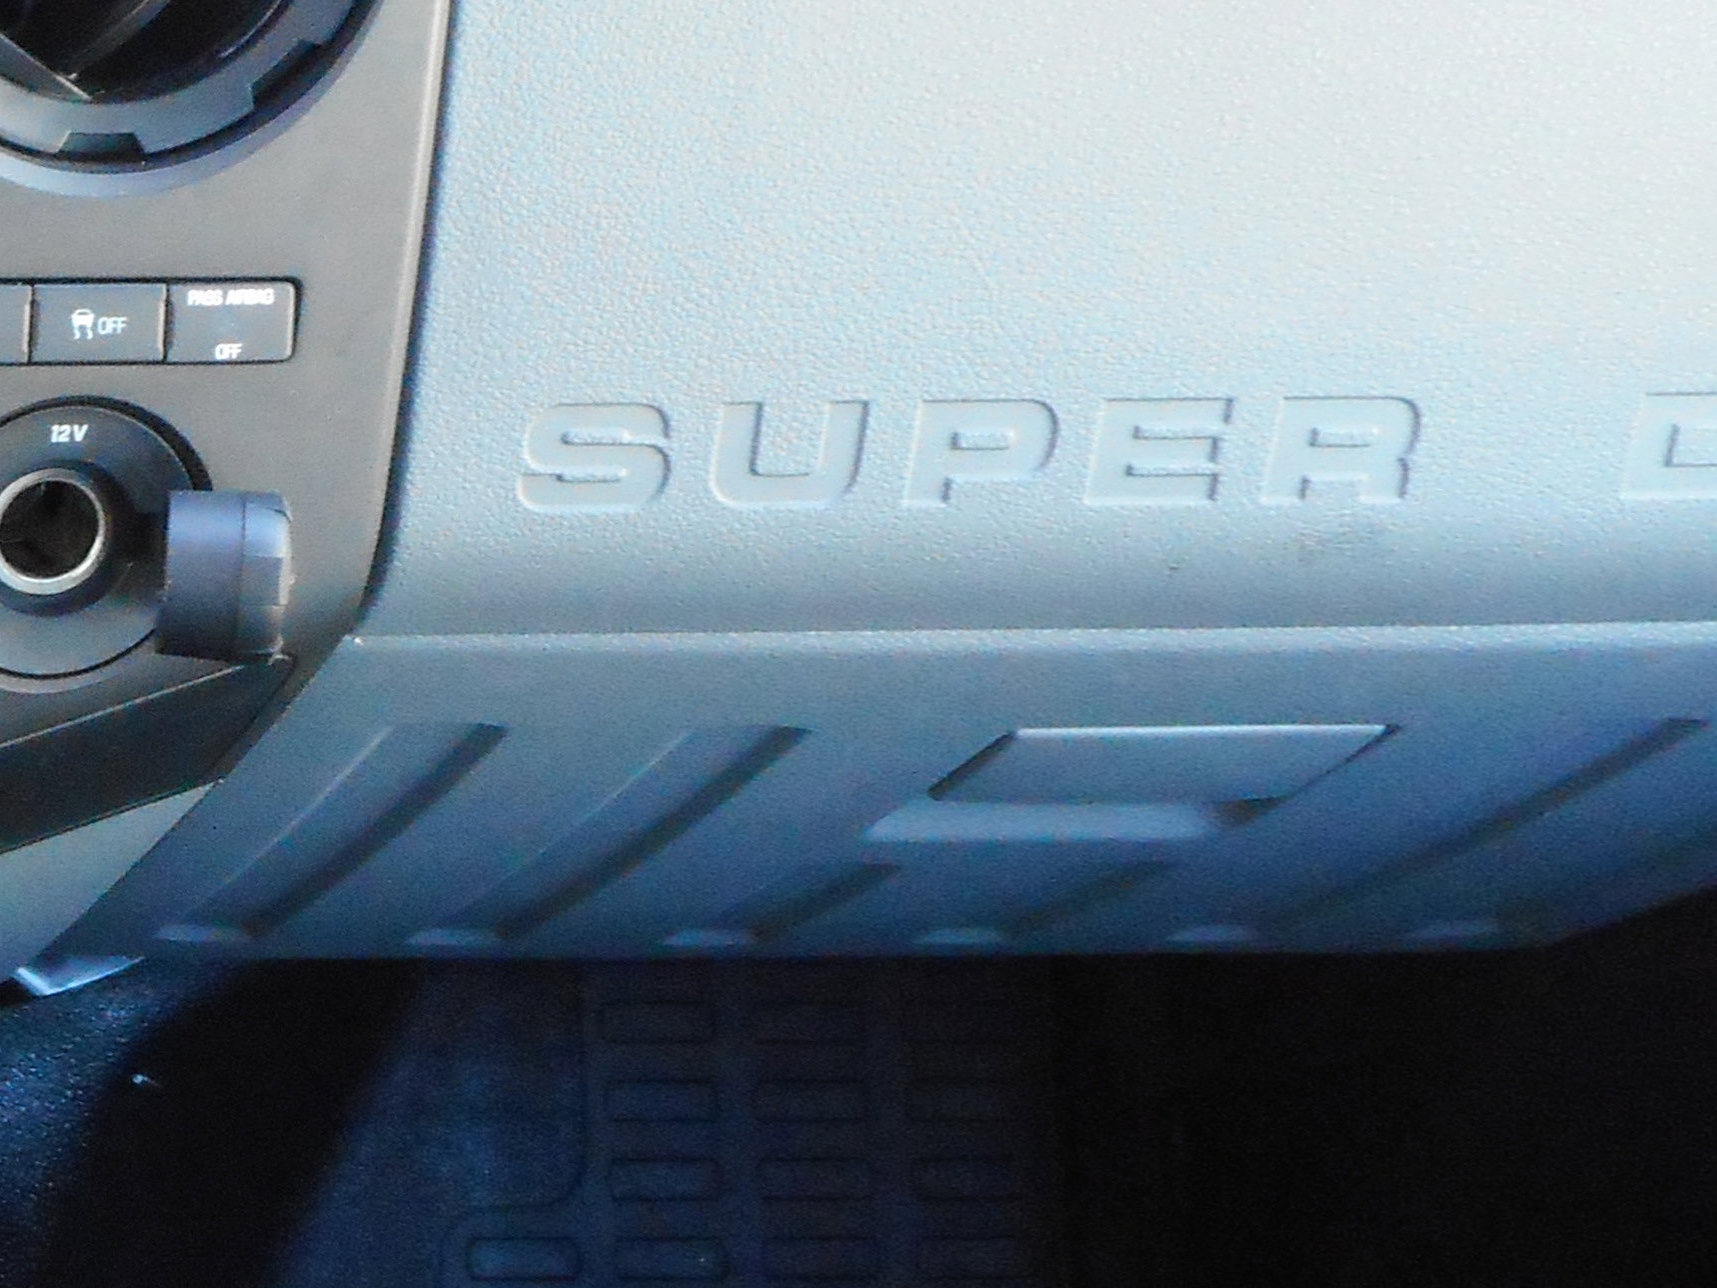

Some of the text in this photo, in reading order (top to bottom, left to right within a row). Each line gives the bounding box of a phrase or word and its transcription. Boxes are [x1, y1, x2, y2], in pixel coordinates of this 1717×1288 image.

[97, 316, 128, 335] OFF
[215, 343, 243, 360] OFF
[50, 423, 89, 443] 12V
[515, 395, 1422, 512] SUPER
